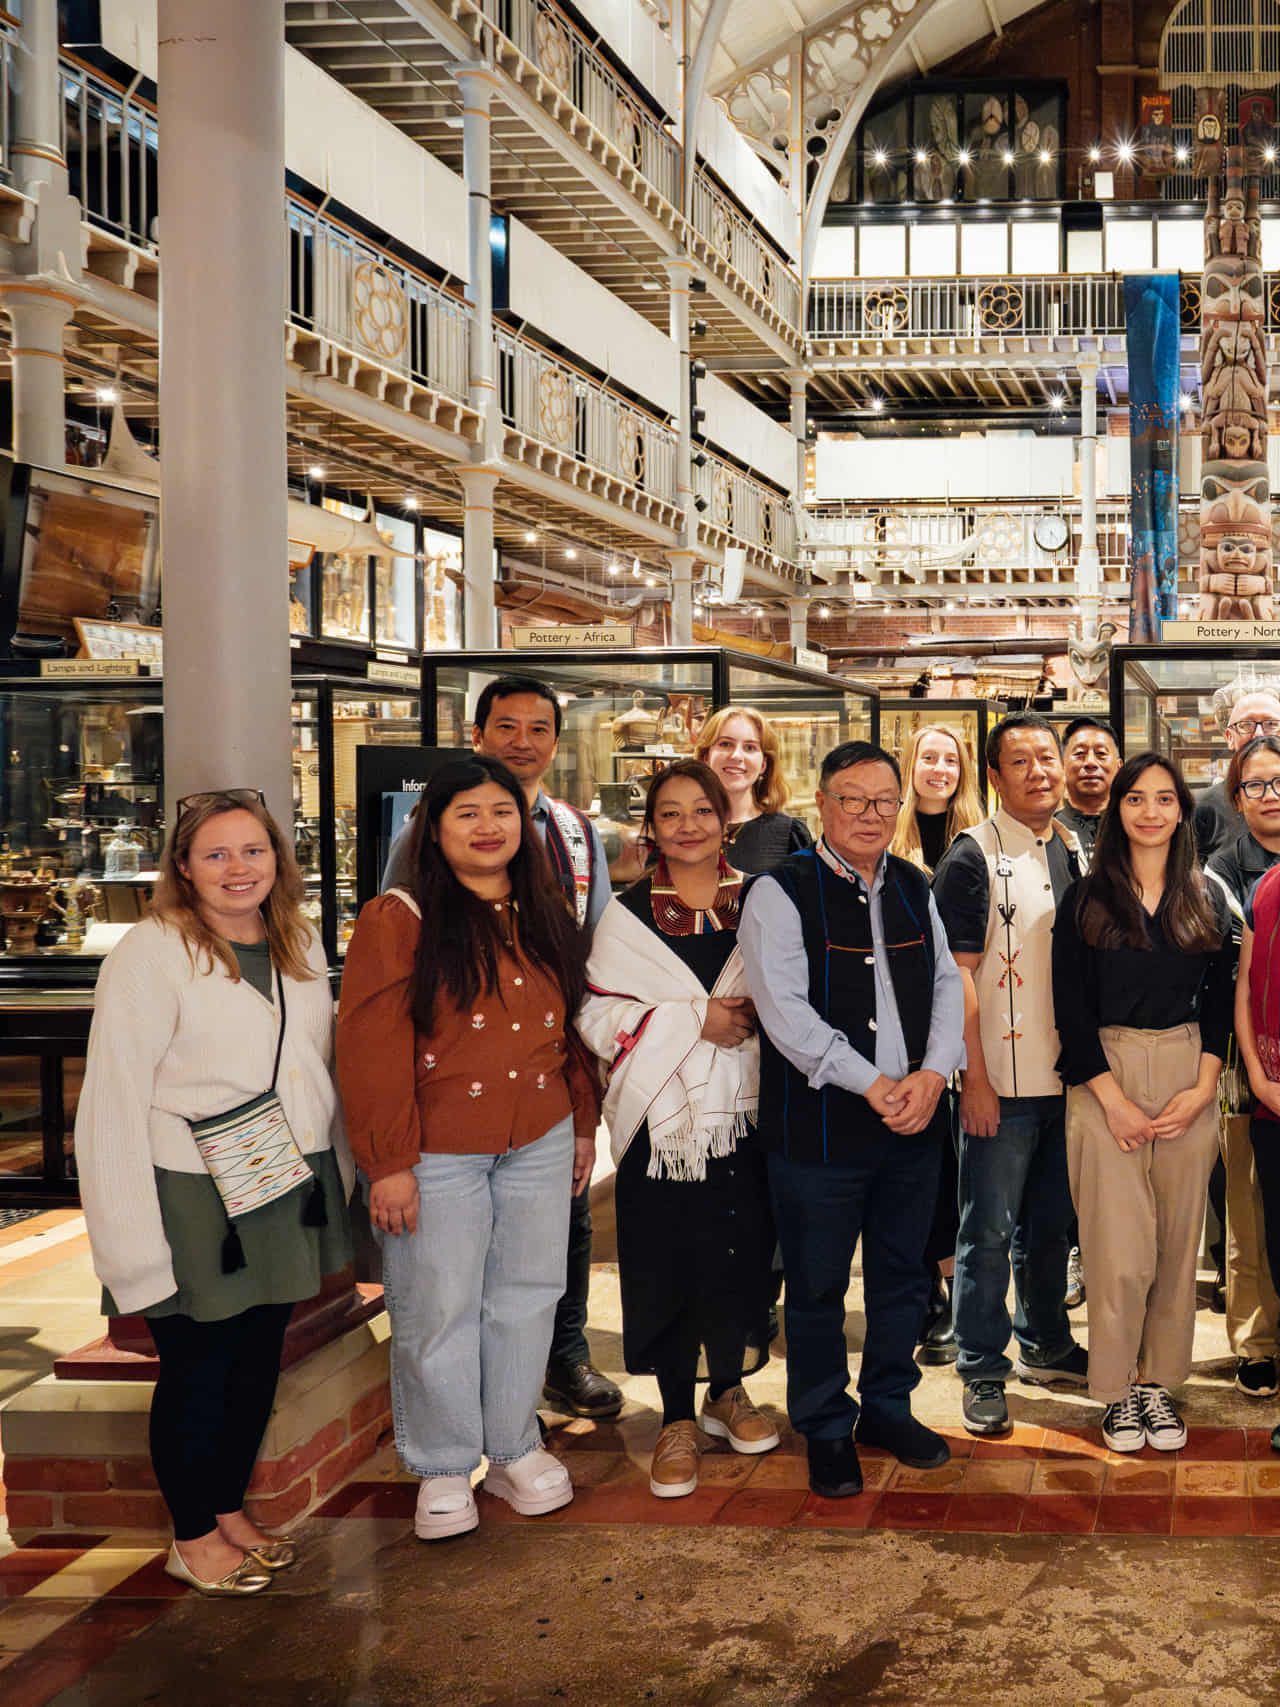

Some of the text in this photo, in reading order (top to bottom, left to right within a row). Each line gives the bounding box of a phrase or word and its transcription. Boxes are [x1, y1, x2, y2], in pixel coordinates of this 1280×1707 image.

[529, 632, 571, 645] Pottery
[583, 631, 616, 642] Africa
[1197, 626, 1241, 639] Pottery
